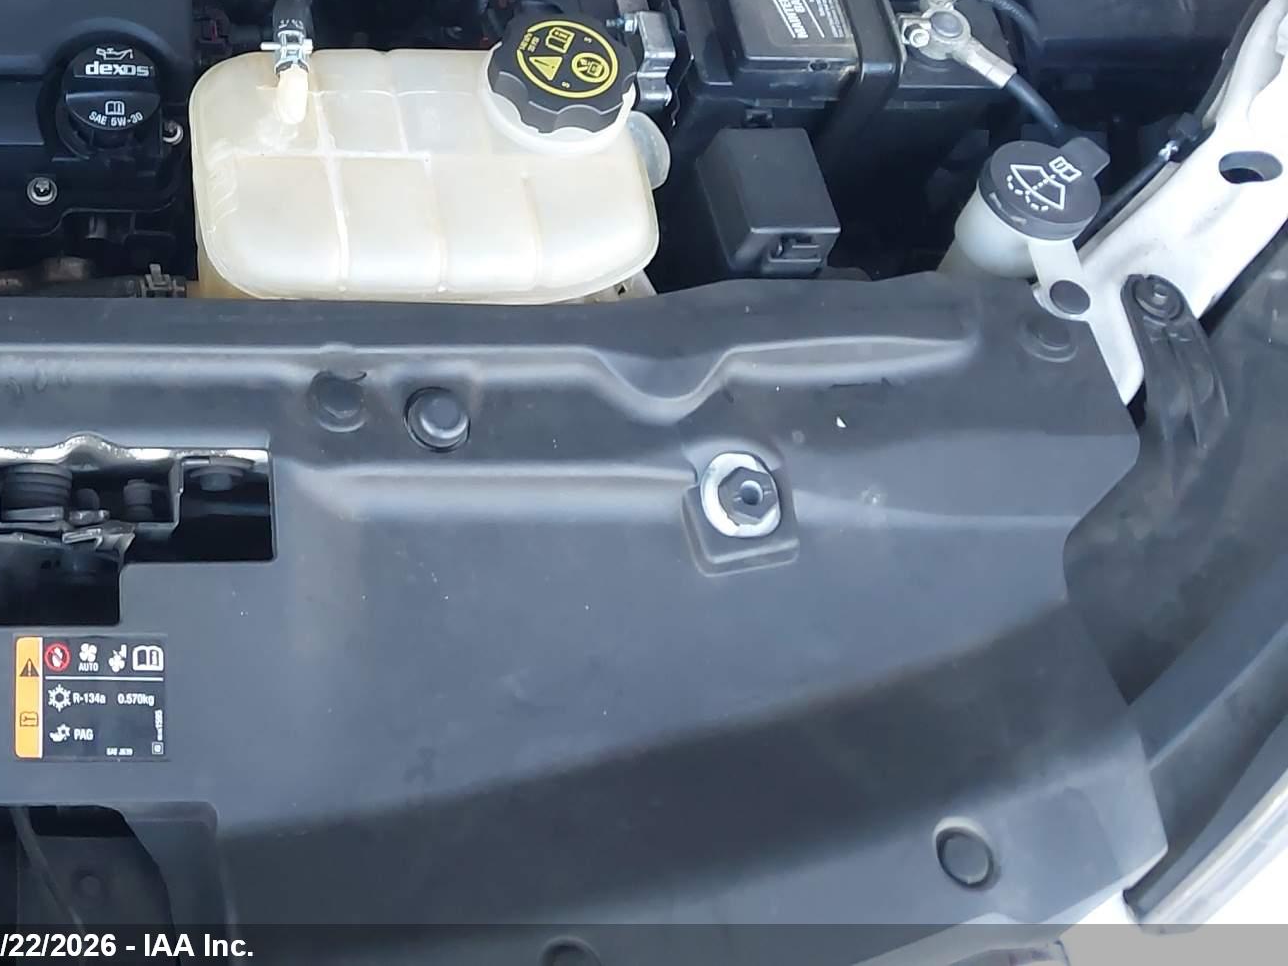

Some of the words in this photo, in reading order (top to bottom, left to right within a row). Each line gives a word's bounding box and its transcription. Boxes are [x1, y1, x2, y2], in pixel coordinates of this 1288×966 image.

[85, 60, 149, 77] dexos
[88, 111, 108, 126] SAE
[78, 662, 99, 672] AUTO
[72, 692, 107, 704] R-134a
[73, 728, 94, 741] PAG
